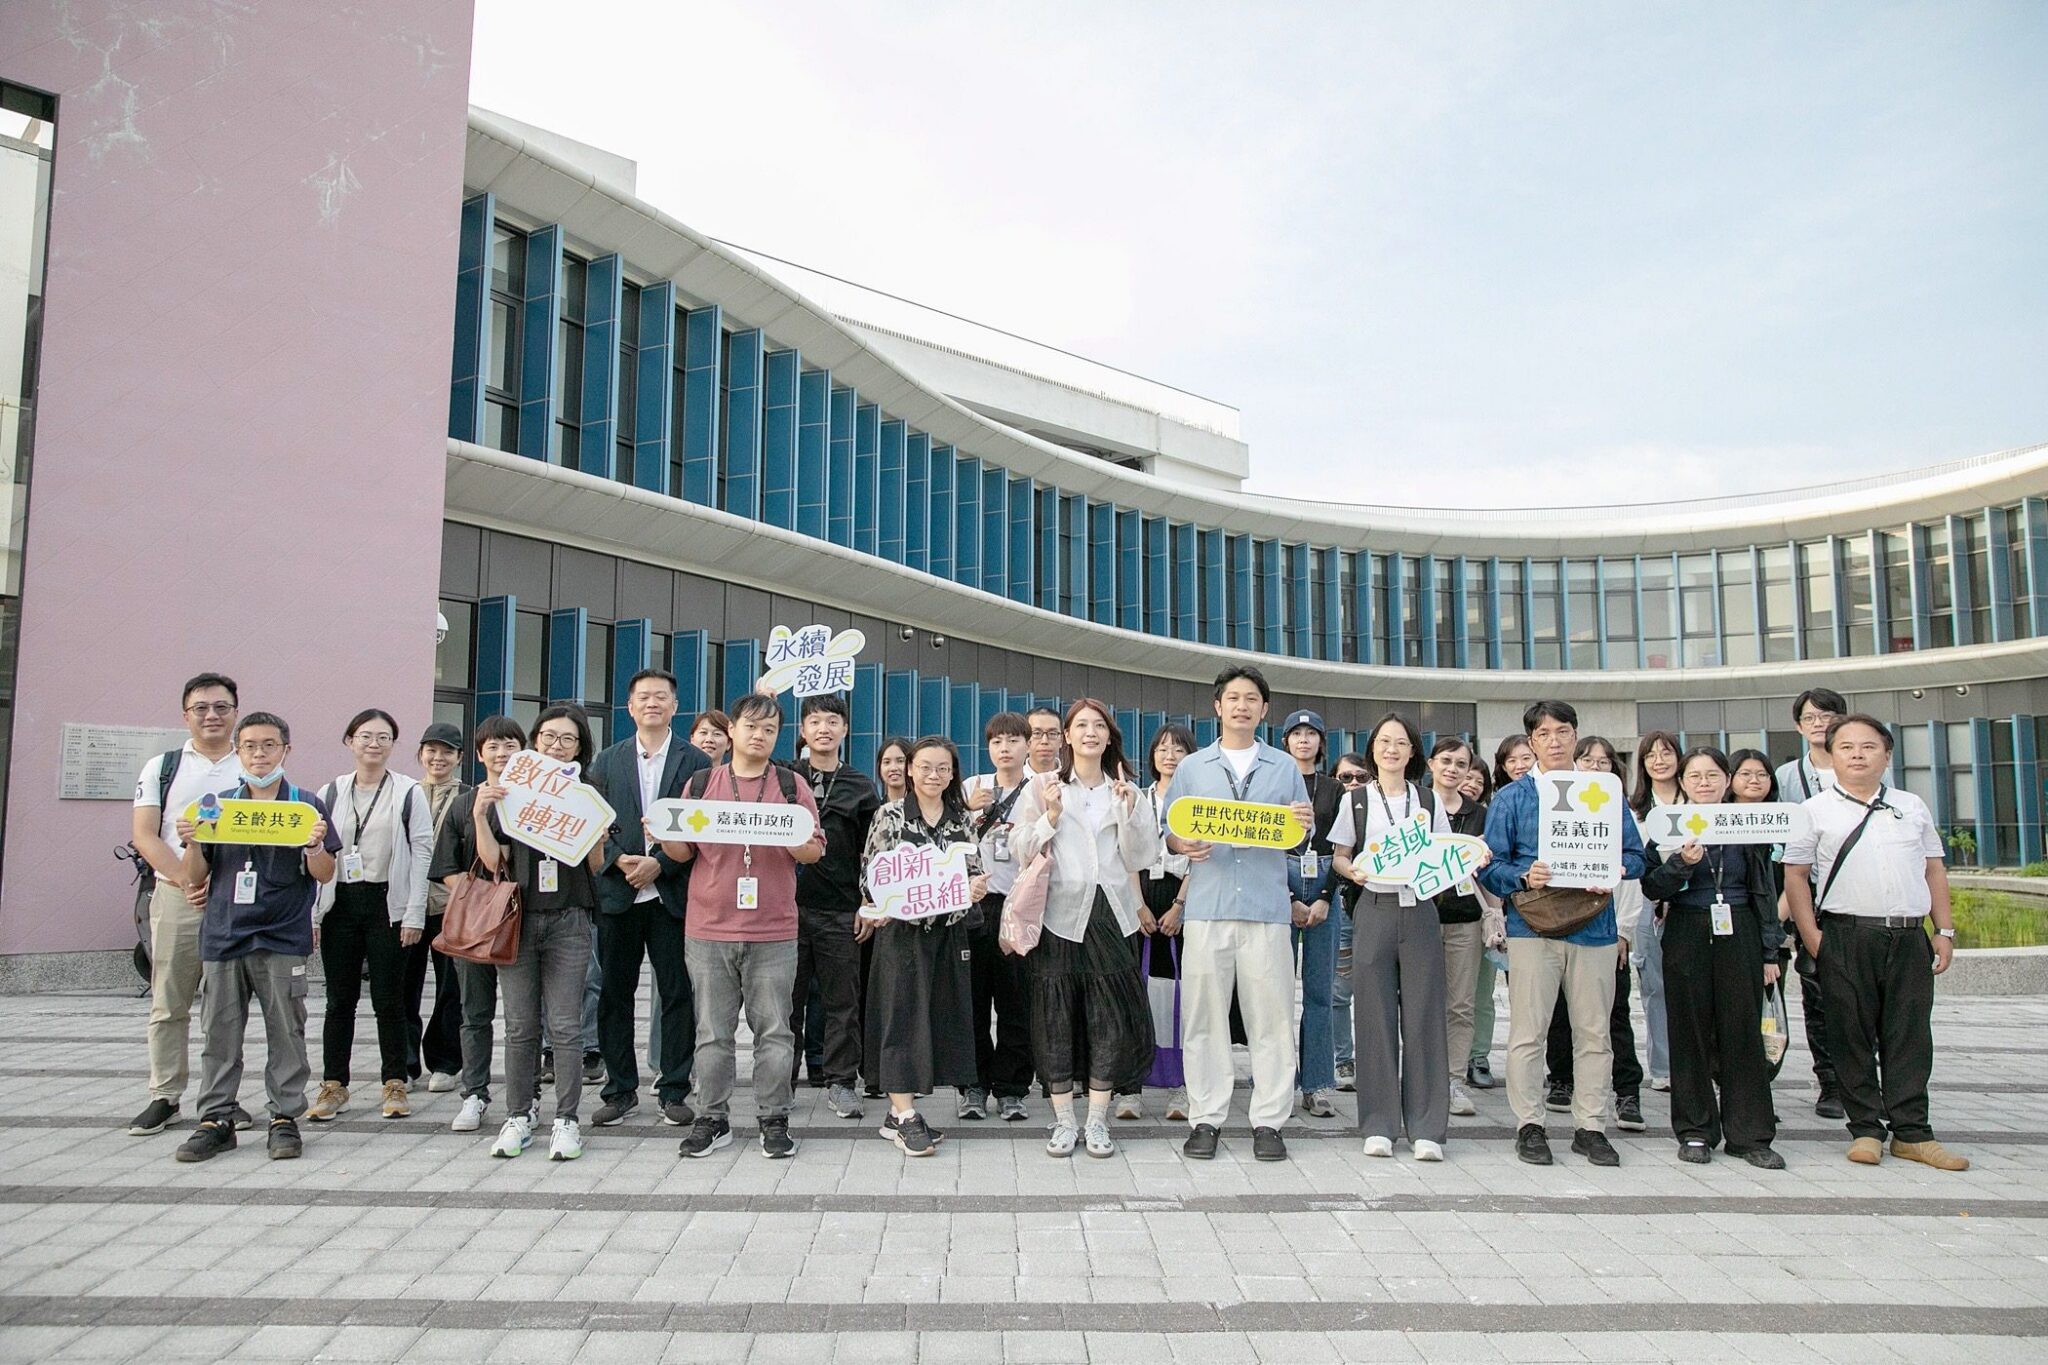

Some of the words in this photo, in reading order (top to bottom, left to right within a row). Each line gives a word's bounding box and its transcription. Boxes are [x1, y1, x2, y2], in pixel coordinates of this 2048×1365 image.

[770, 629, 828, 662] 永續
[796, 660, 851, 694] 發展
[505, 755, 576, 799] 數位
[232, 810, 304, 828] 全齡共享
[515, 800, 588, 846] 轉型
[716, 812, 794, 828] 嘉義市政府
[1552, 820, 1609, 838] 嘉義市
[1714, 812, 1790, 826] 嘉義市政府
[1373, 820, 1432, 874] 跨域
[872, 847, 933, 887] 創新
[1414, 844, 1472, 895] 合作
[908, 878, 967, 915] 思維
